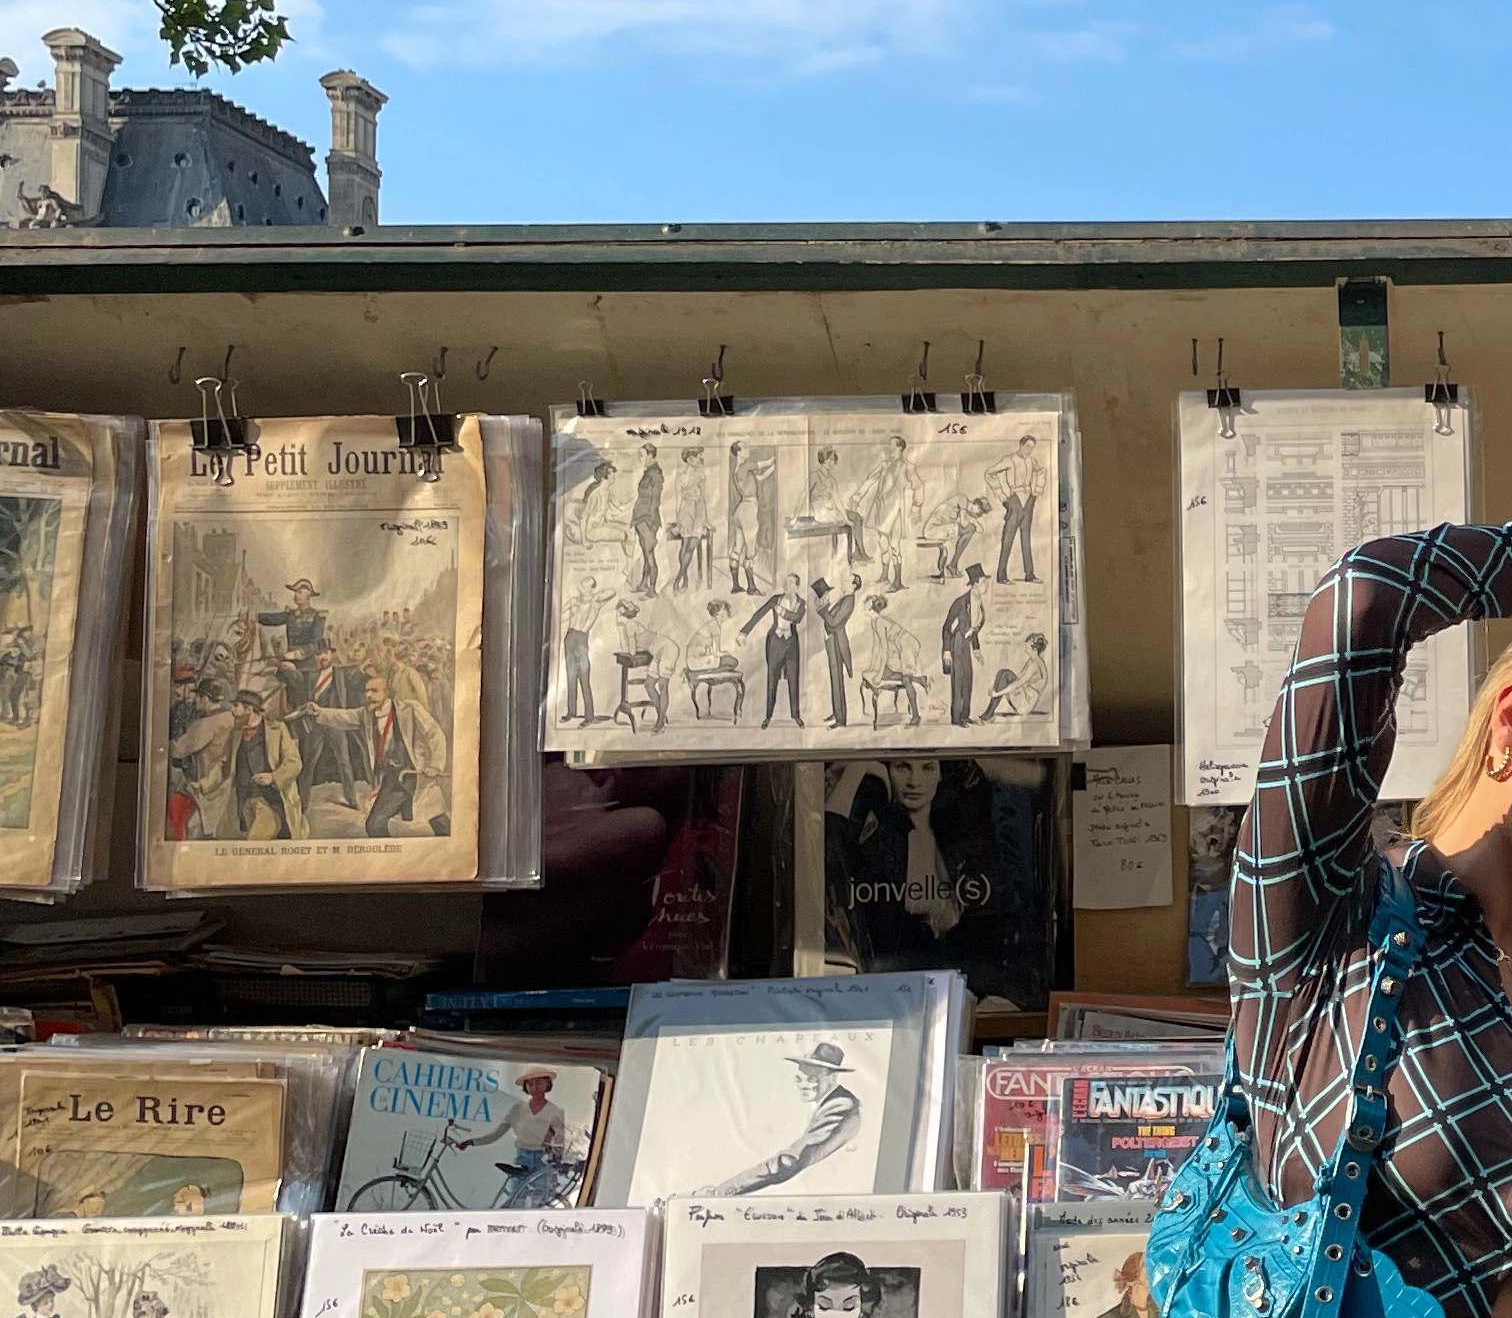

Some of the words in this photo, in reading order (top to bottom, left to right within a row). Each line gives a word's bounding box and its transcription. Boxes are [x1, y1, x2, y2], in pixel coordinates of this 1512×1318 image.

[245, 443, 308, 476] Petit
[316, 846, 329, 855] ET
[849, 873, 992, 909] jonvelle(s)
[673, 1037, 715, 1047] LES
[736, 1032, 875, 1046] CHAPEAUX
[374, 1058, 501, 1095] CAHIERS
[68, 1093, 115, 1122] Le
[136, 1096, 227, 1126] Rire
[1089, 1080, 1218, 1119] FANTASTIQU
[1111, 1135, 1200, 1150] POLTERGEIST
